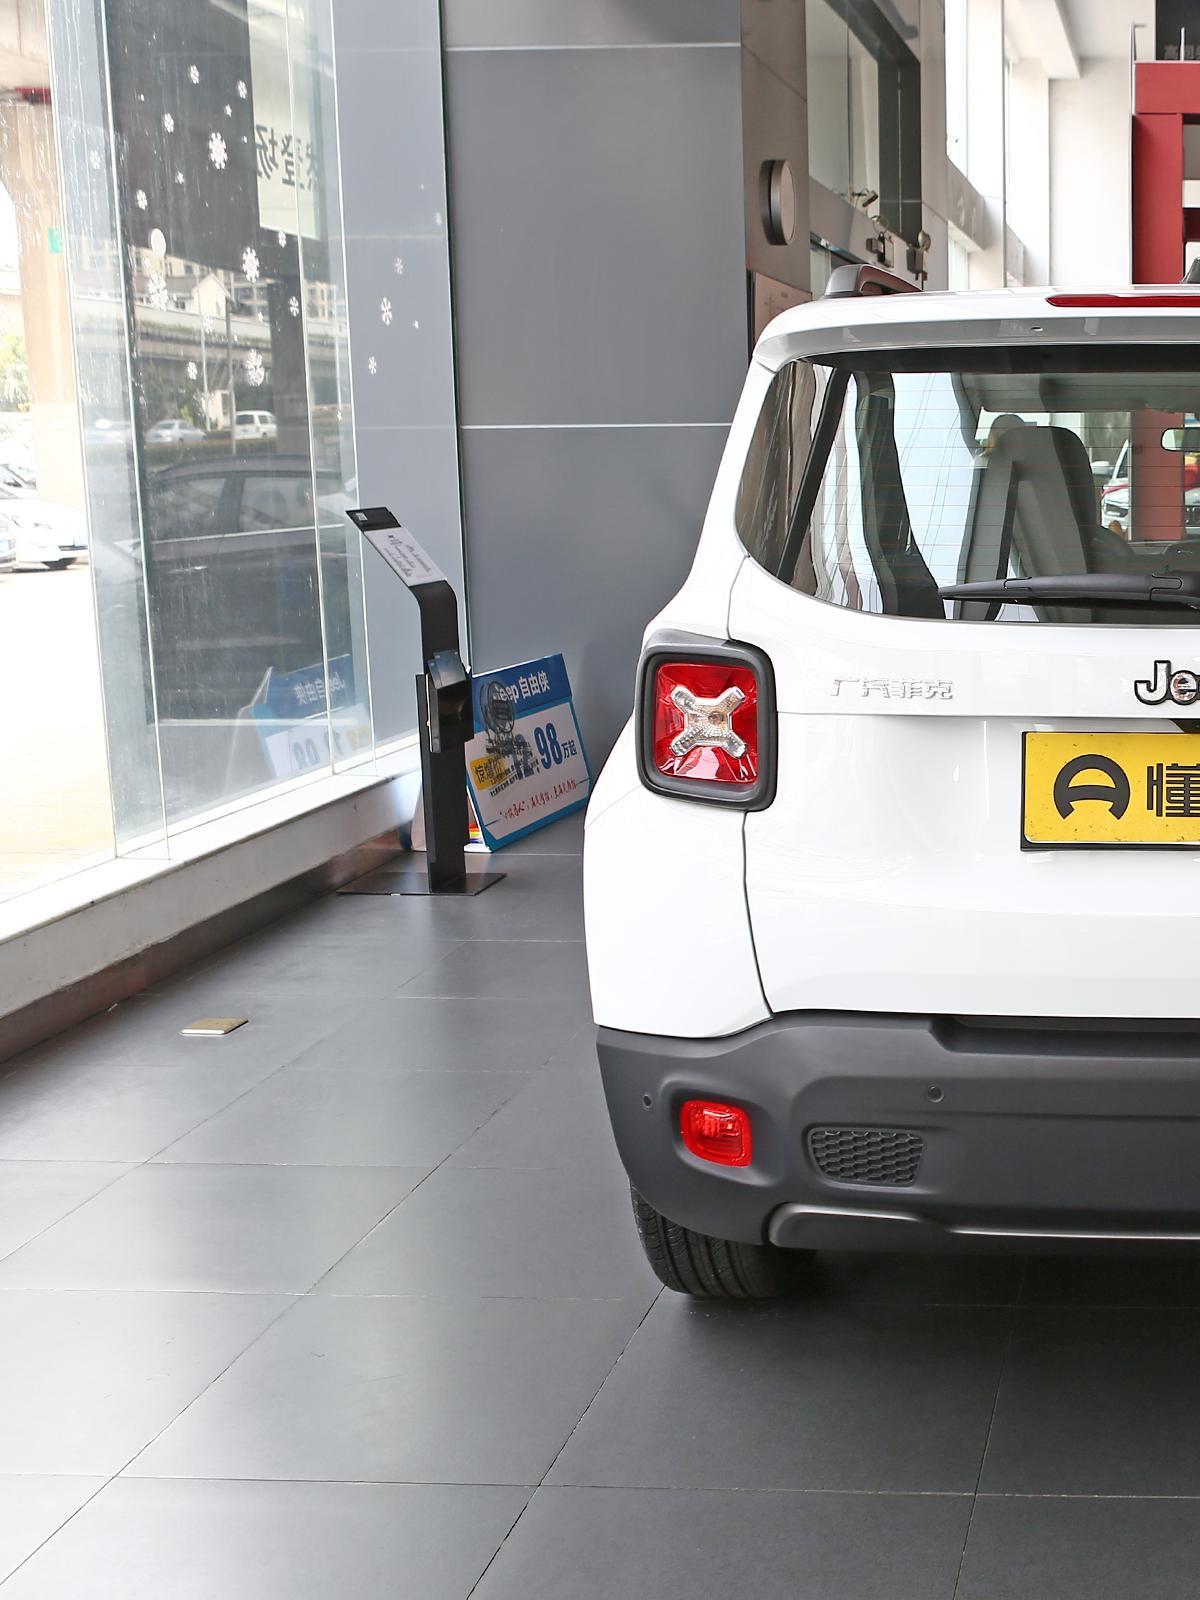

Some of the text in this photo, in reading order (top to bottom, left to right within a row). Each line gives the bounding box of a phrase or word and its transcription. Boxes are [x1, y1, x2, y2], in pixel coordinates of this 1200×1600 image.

[518, 670, 551, 699] 自由侠
[830, 677, 954, 701] 广汽菲克
